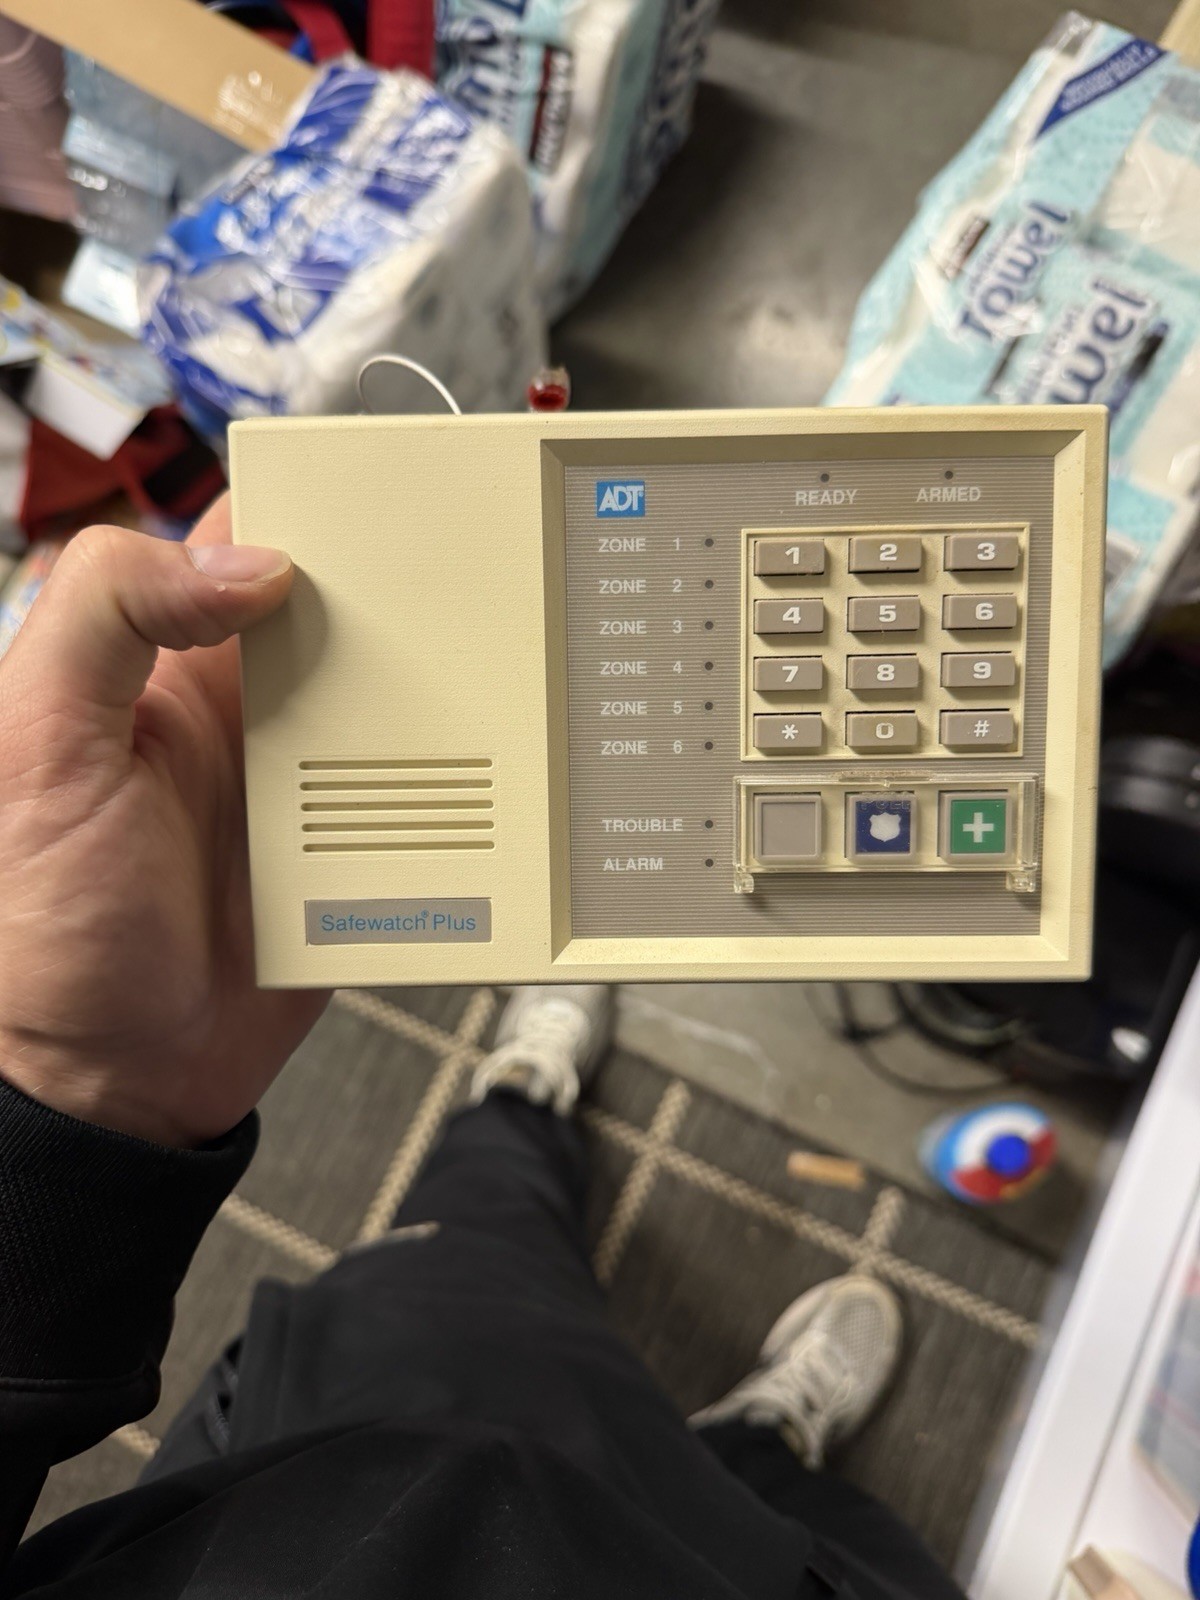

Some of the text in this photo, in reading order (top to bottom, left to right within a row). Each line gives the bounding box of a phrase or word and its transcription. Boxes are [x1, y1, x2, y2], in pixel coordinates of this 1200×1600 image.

[962, 201, 1067, 340] Towel
[1050, 281, 1147, 405] wel
[598, 485, 644, 512] ADT
[795, 489, 857, 506] READY
[916, 486, 981, 503] ARMED
[598, 538, 681, 553] ZONE 1
[879, 543, 898, 561] 2
[976, 542, 996, 560] 3
[784, 547, 800, 565] 1
[599, 579, 682, 594] ZONE 2
[782, 606, 801, 624] 4
[878, 605, 897, 622] 5
[975, 603, 994, 620] 6
[600, 620, 682, 635] ZONE 3
[600, 660, 683, 675] ZONE 4
[782, 665, 799, 683] 7
[876, 664, 895, 681] 8
[973, 661, 991, 679] 9
[600, 701, 682, 715] ZONE 5
[875, 722, 894, 739] 0
[973, 719, 990, 737] #
[601, 740, 683, 755] ZONE 6
[601, 818, 684, 832] TROUBLE
[602, 858, 664, 871] ALARM
[433, 913, 477, 931] Plus
